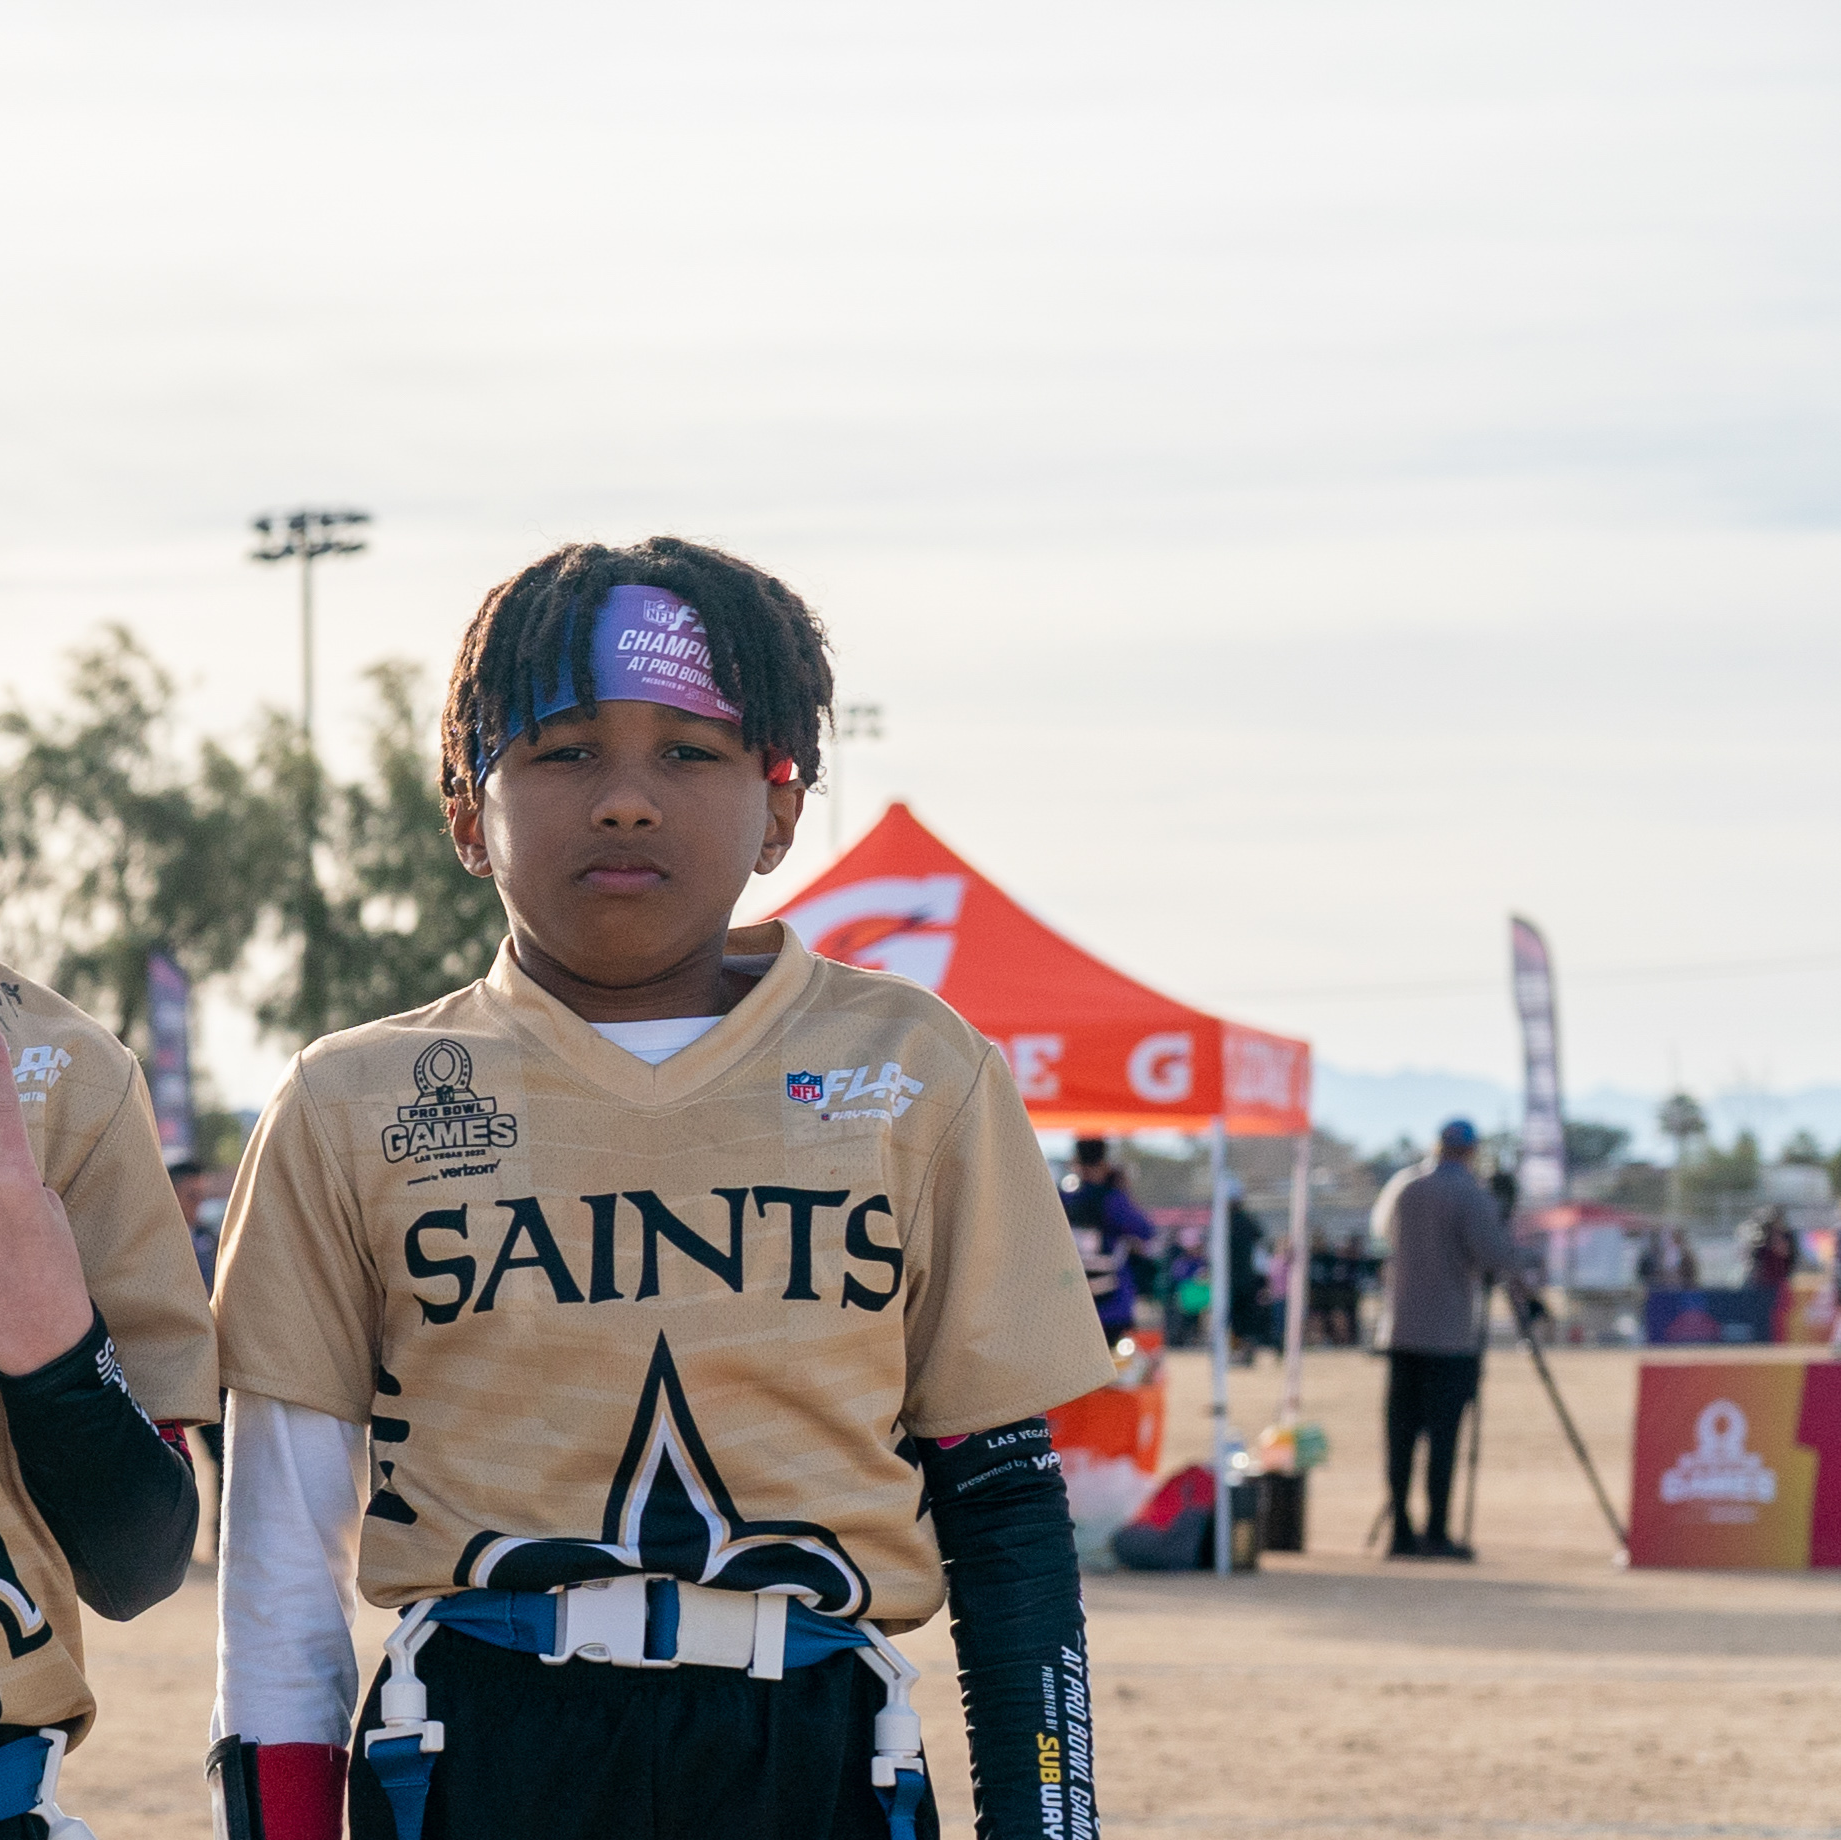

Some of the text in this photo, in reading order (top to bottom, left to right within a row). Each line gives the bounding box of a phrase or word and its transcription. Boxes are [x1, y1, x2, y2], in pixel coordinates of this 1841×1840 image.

[626, 656, 651, 671] AT
[648, 658, 679, 677] PRO
[1125, 1031, 1193, 1104] G
[790, 1085, 821, 1099] NFL
[409, 1103, 485, 1119] PRO BOWL
[382, 1113, 518, 1164] GAMES
[415, 1155, 431, 1163] LAS
[433, 1151, 463, 1160] VEGAS
[440, 1163, 494, 1179] verizon
[403, 1187, 904, 1326] SAINTS
[987, 1434, 1017, 1449] LAS
[957, 1461, 1013, 1492] presented
[1014, 1459, 1027, 1468] by
[1061, 1645, 1083, 1677] AT
[1041, 1665, 1058, 1731] PRESENTED BY
[1063, 1674, 1088, 1721] PRO
[1067, 1719, 1090, 1783] BOWL
